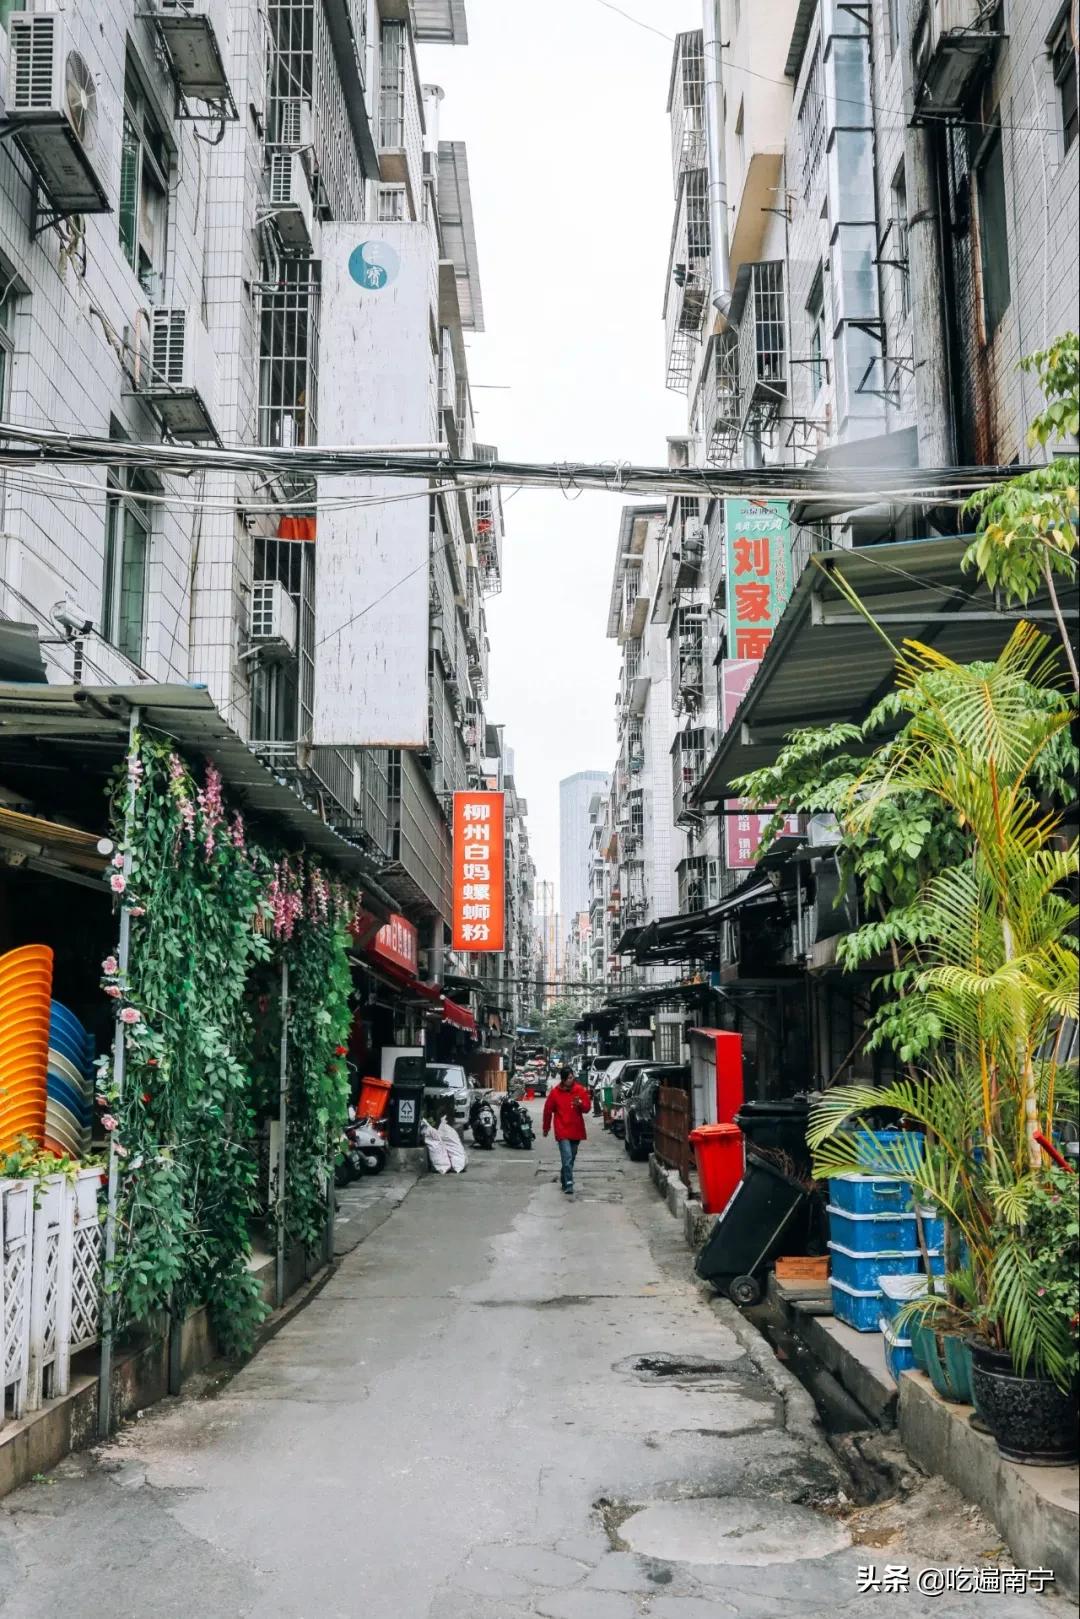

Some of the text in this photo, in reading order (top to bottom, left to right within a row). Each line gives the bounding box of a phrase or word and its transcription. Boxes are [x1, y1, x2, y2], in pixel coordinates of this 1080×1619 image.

[462, 804, 490, 941] 柳州白妈螺蛳粉
